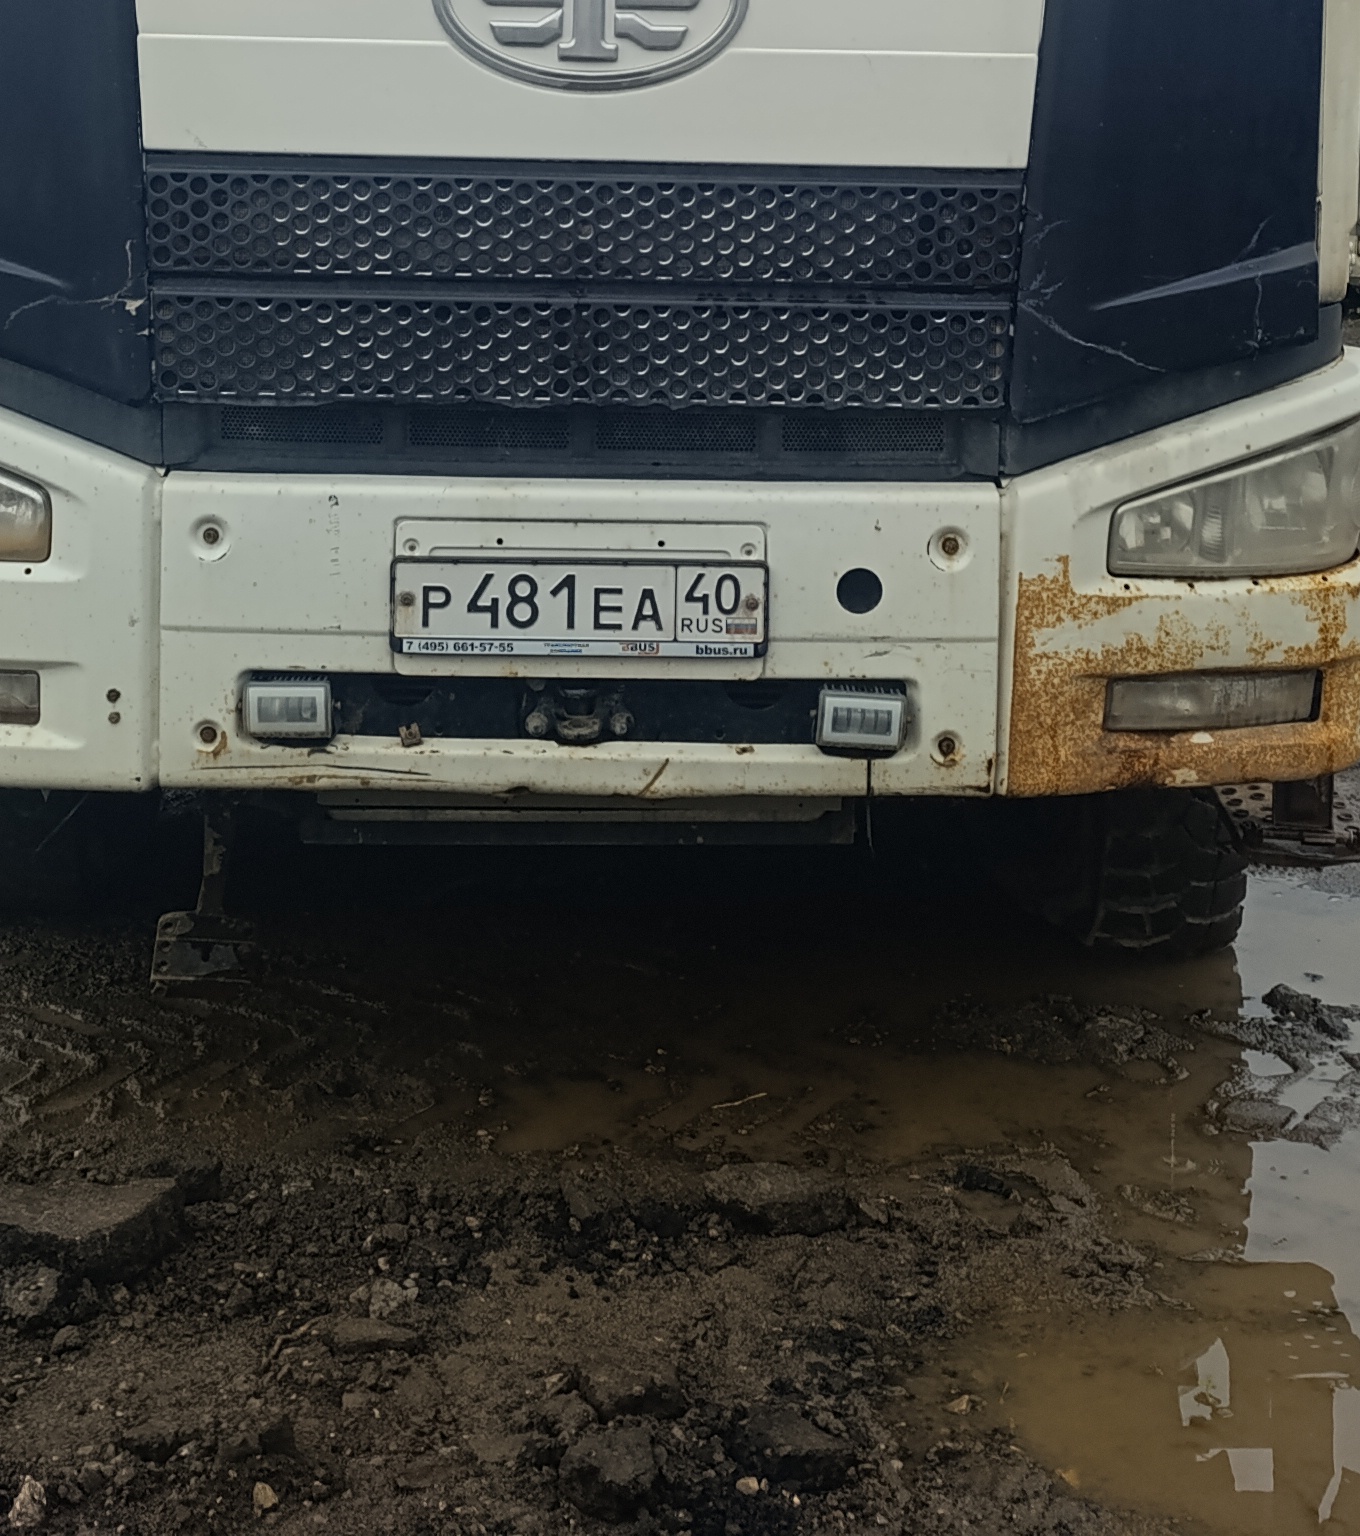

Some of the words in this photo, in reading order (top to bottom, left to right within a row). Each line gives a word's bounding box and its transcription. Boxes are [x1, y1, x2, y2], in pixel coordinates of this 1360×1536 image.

[684, 572, 741, 616] 40
[680, 617, 724, 635] RUS
[406, 641, 414, 651] 7
[418, 641, 449, 652] (495)
[453, 642, 514, 652] 661-57-55
[695, 644, 748, 655] bbus.ru
